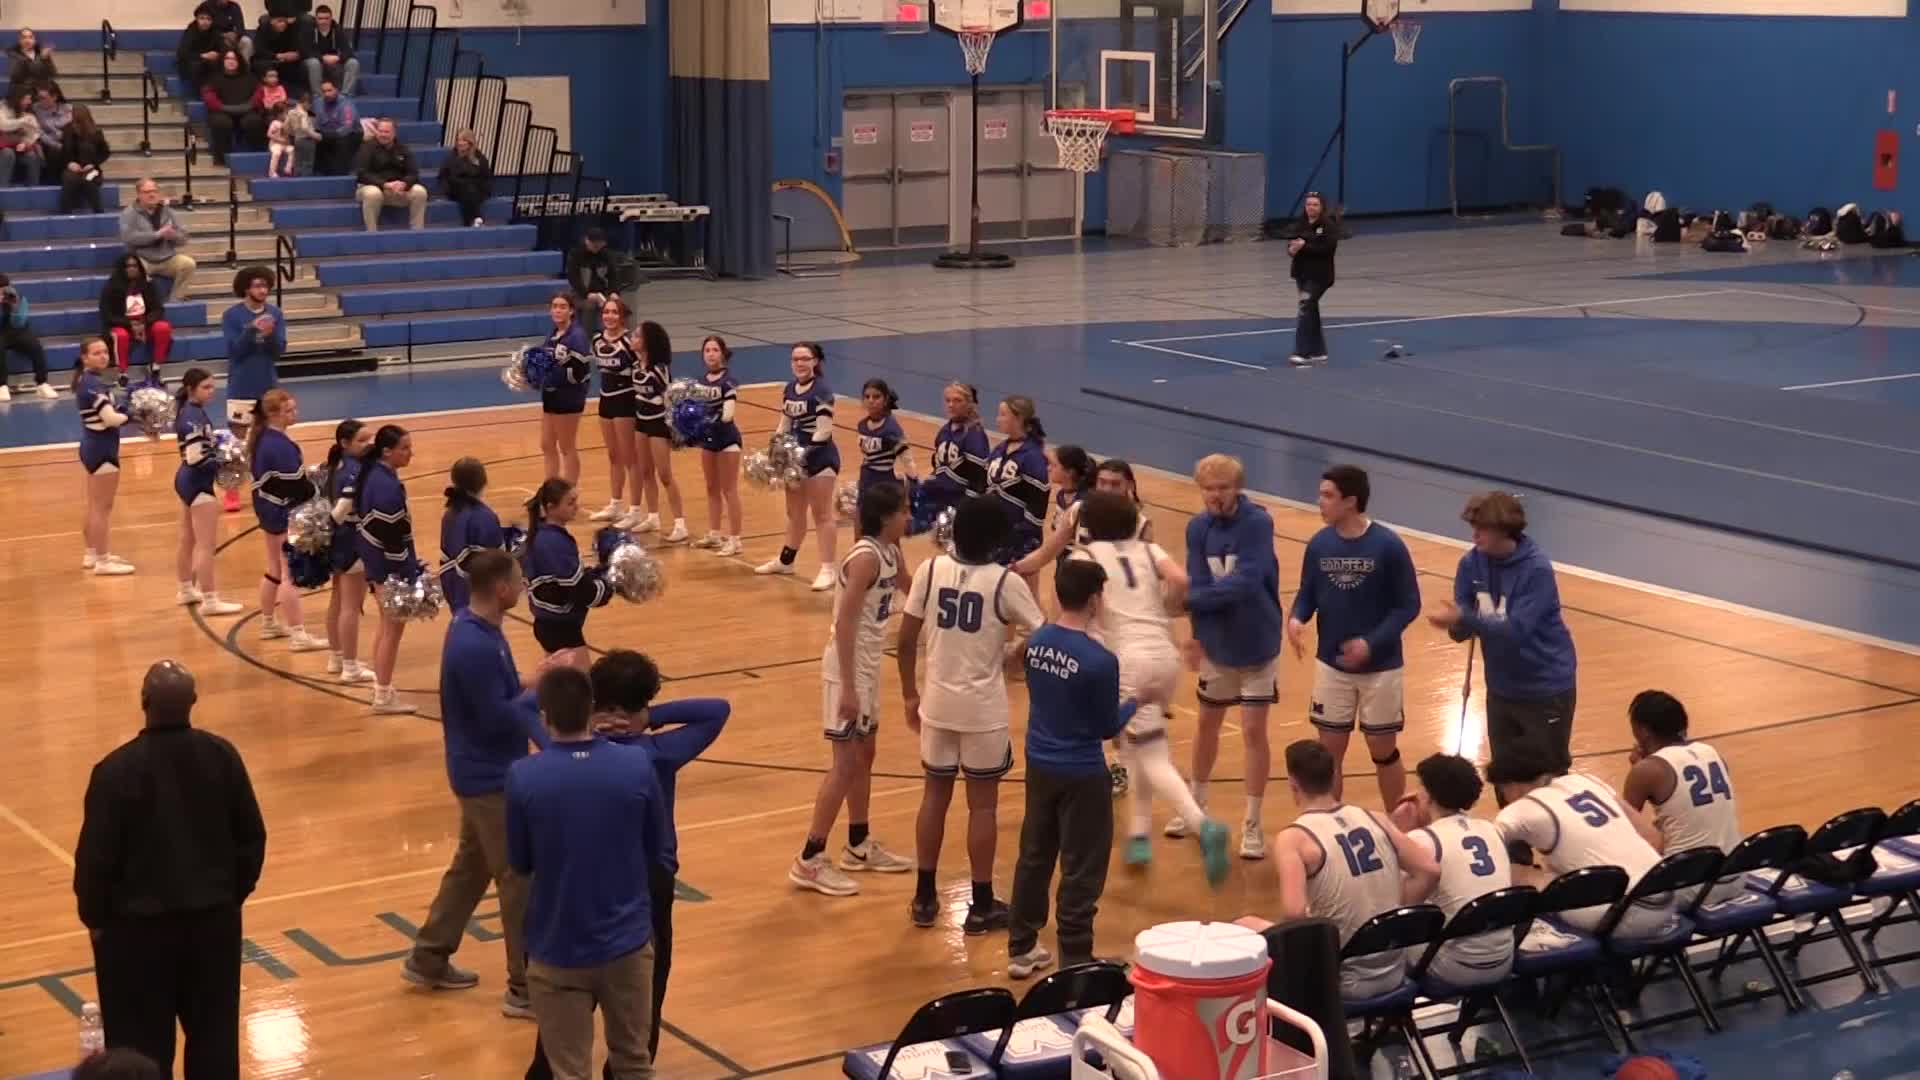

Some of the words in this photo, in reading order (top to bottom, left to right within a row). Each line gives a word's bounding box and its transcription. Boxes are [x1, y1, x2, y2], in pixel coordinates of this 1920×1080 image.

[1116, 556, 1136, 588] 1
[937, 587, 984, 634] 50
[1026, 645, 1080, 673] NIANG
[1030, 657, 1070, 680] GANG
[1683, 761, 1732, 807] 24
[1566, 789, 1620, 828] 51
[1335, 827, 1384, 877] 12
[1461, 836, 1497, 877] 3
[1226, 1000, 1257, 1045] G
